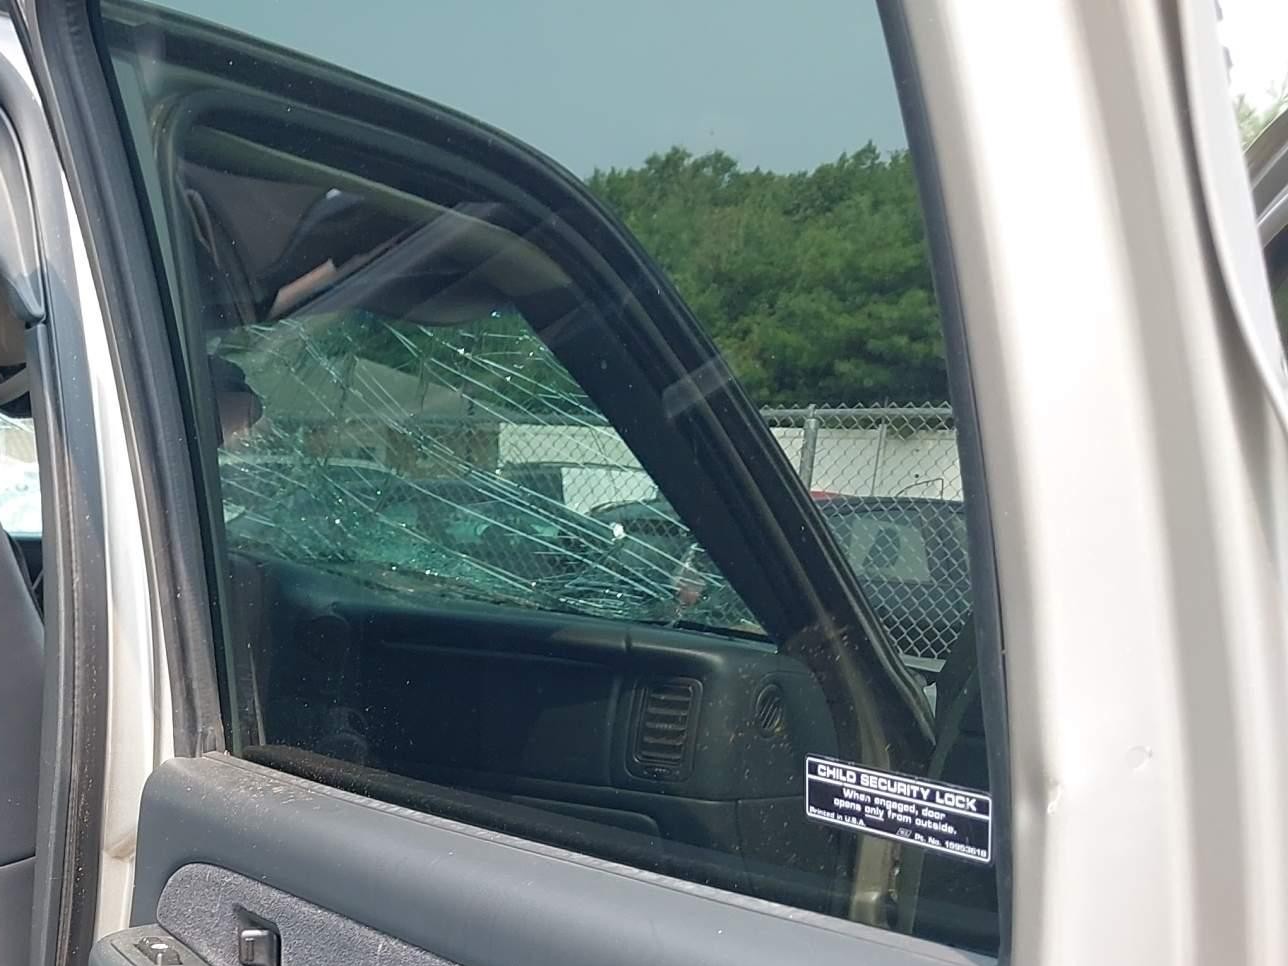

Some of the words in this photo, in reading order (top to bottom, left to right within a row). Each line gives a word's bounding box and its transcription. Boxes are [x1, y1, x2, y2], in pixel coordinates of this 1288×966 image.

[817, 764, 856, 783] CHILD
[860, 773, 930, 800] SECURITY
[936, 790, 977, 811] LOCK
[842, 787, 871, 804] When
[874, 796, 919, 815] engaged,
[921, 806, 946, 819] door
[809, 806, 835, 819] Printed
[836, 813, 844, 821] in
[833, 798, 861, 812] opens
[864, 804, 885, 819] only
[887, 809, 912, 824] from
[915, 815, 957, 835] outside.
